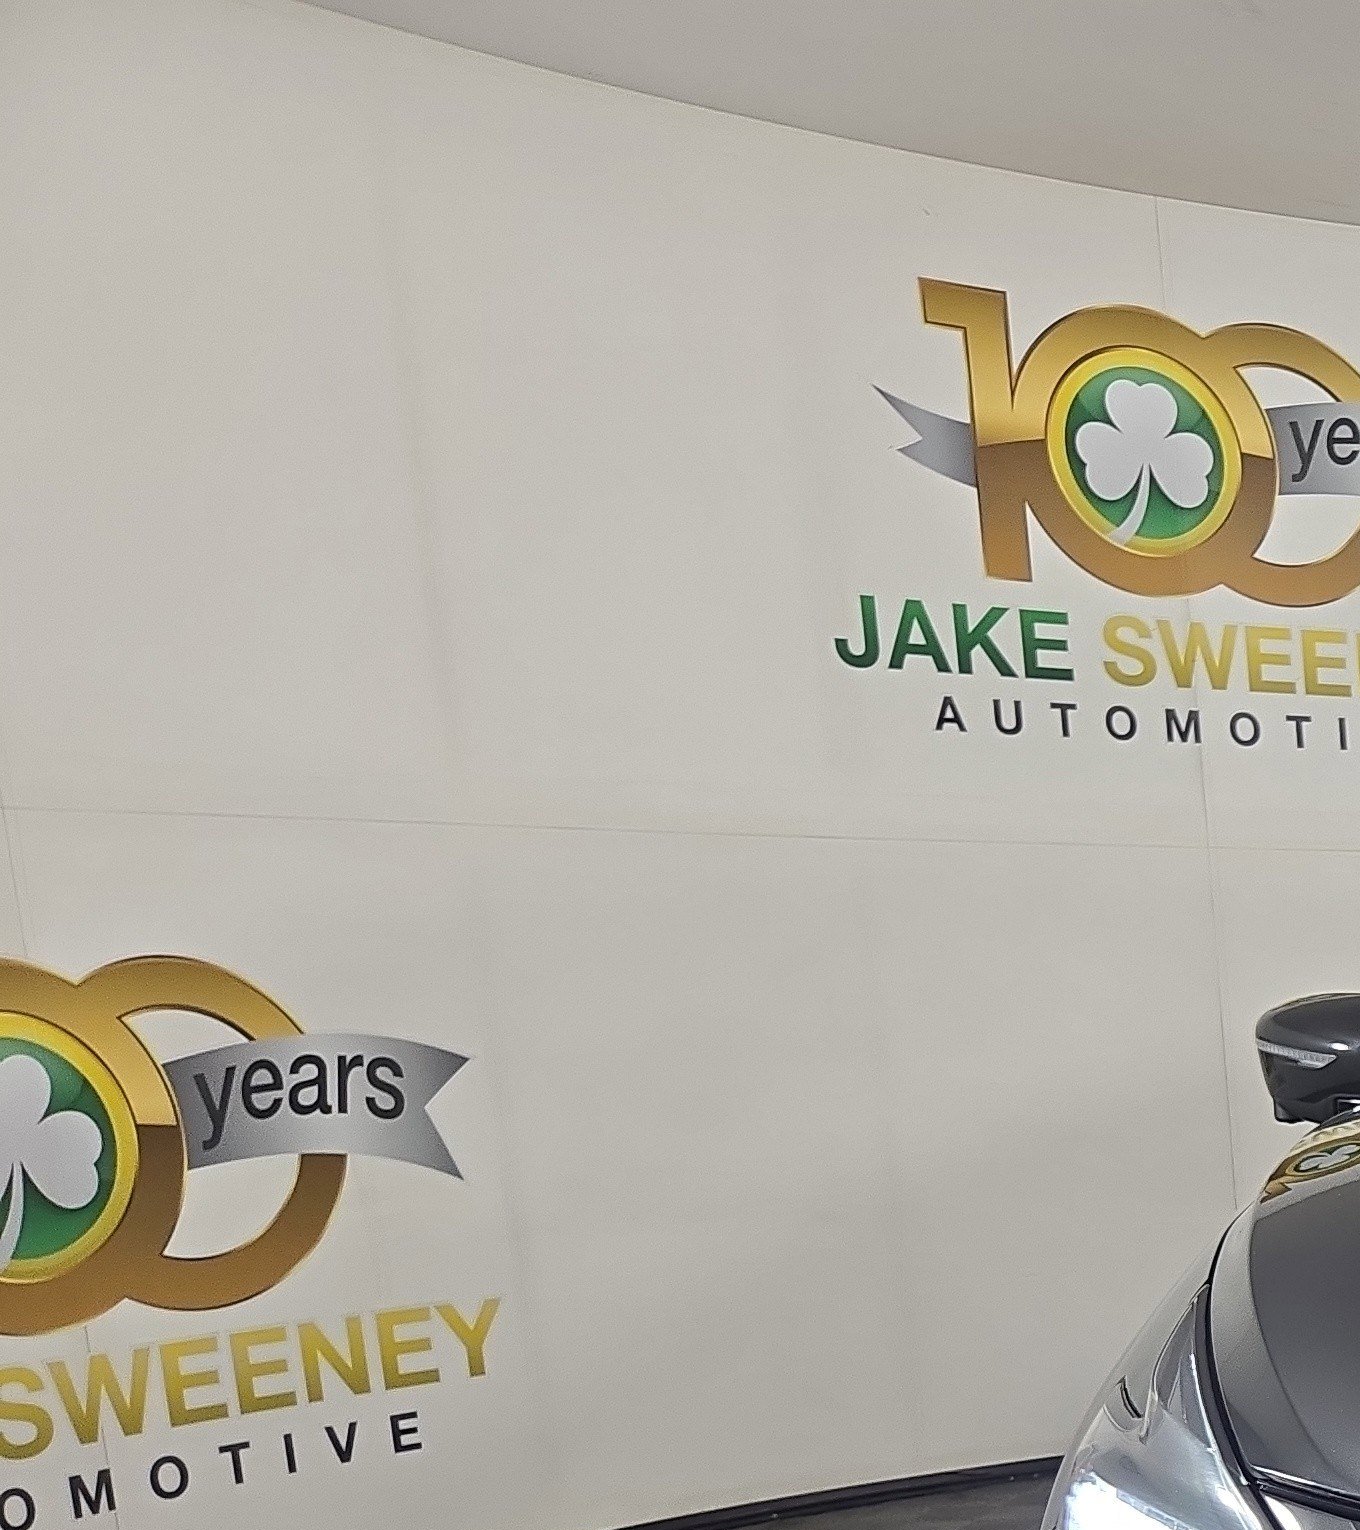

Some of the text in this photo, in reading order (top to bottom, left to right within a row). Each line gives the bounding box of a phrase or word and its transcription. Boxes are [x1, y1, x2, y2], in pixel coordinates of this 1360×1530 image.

[834, 595, 1075, 681] JAKE
[193, 1052, 406, 1150] years
[0, 1298, 500, 1460] SWEENEY
